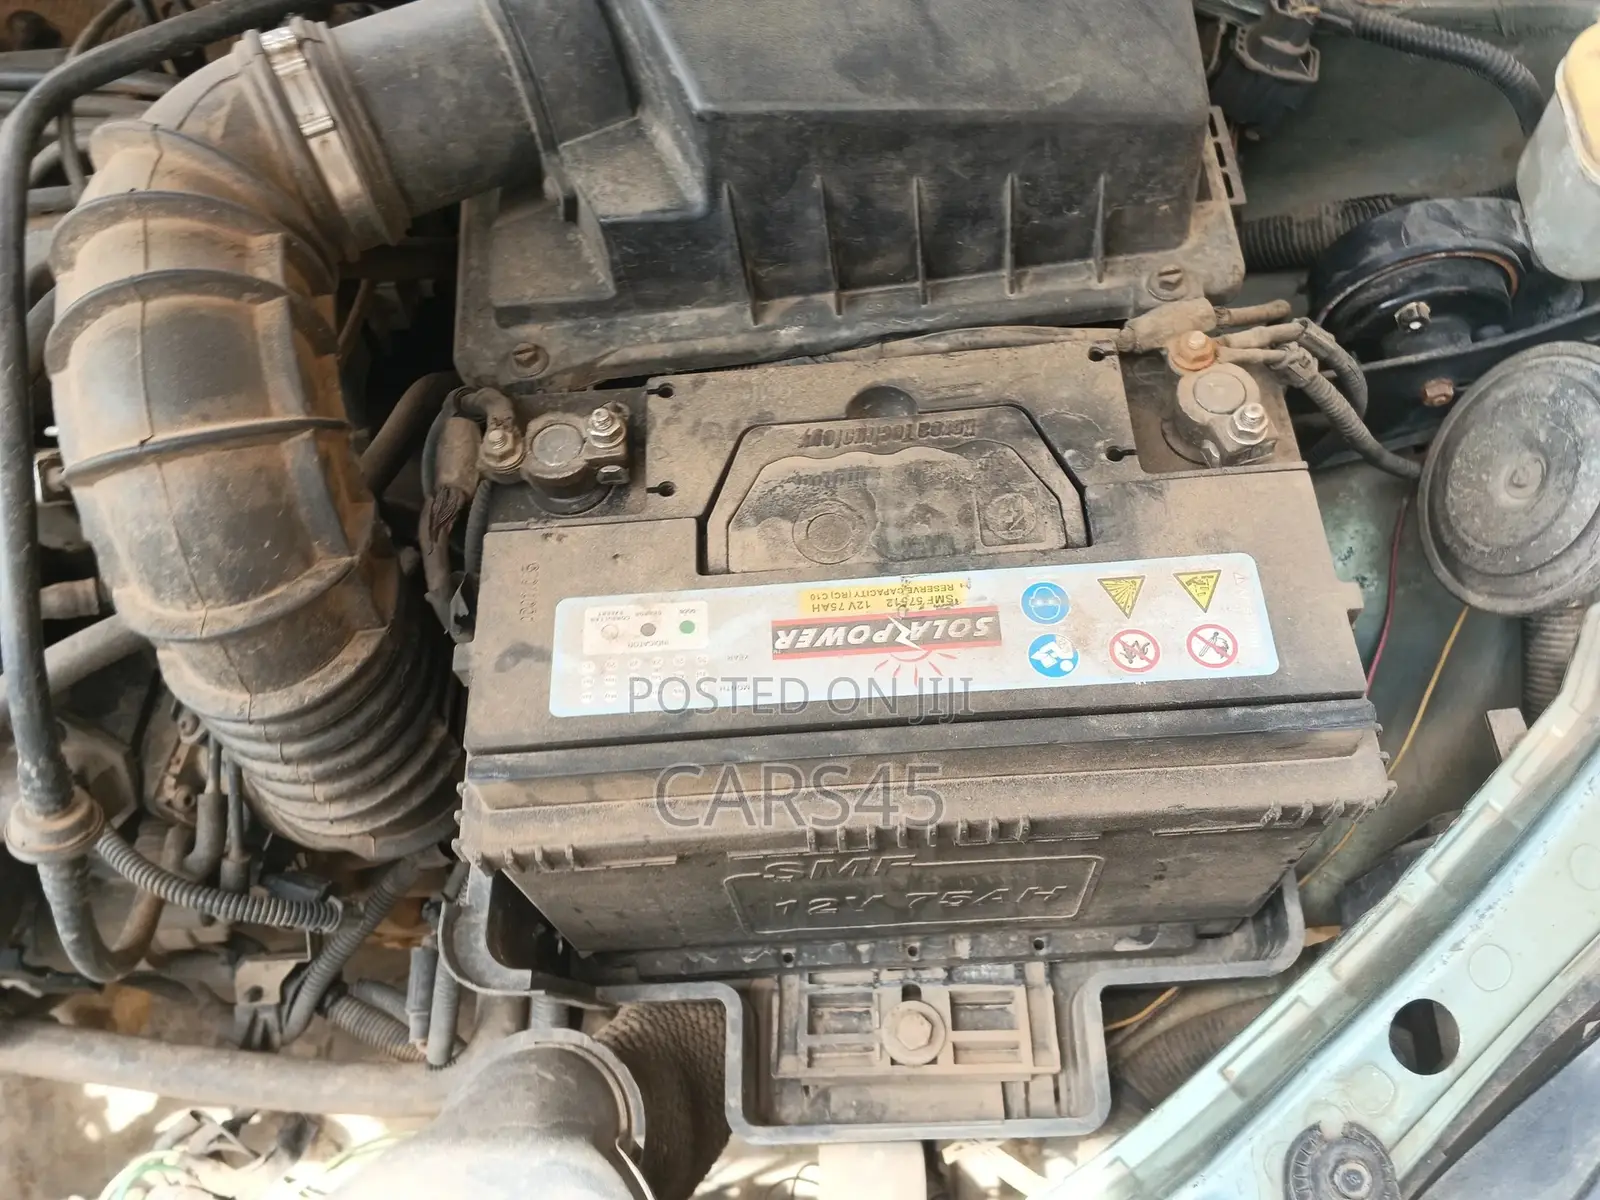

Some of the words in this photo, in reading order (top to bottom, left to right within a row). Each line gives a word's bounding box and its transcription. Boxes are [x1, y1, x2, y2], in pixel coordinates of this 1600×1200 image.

[854, 586, 904, 597] CAPACITY
[908, 583, 955, 594] RESERVE
[810, 592, 829, 601] C10
[831, 590, 853, 600] (RC)
[926, 594, 955, 607] SMF
[812, 601, 845, 613] 75AH
[847, 600, 871, 610] 12V
[886, 596, 924, 608] 57512
[762, 854, 917, 882] SMF
[774, 892, 886, 916] 12V
[904, 884, 1068, 911] 75AH
